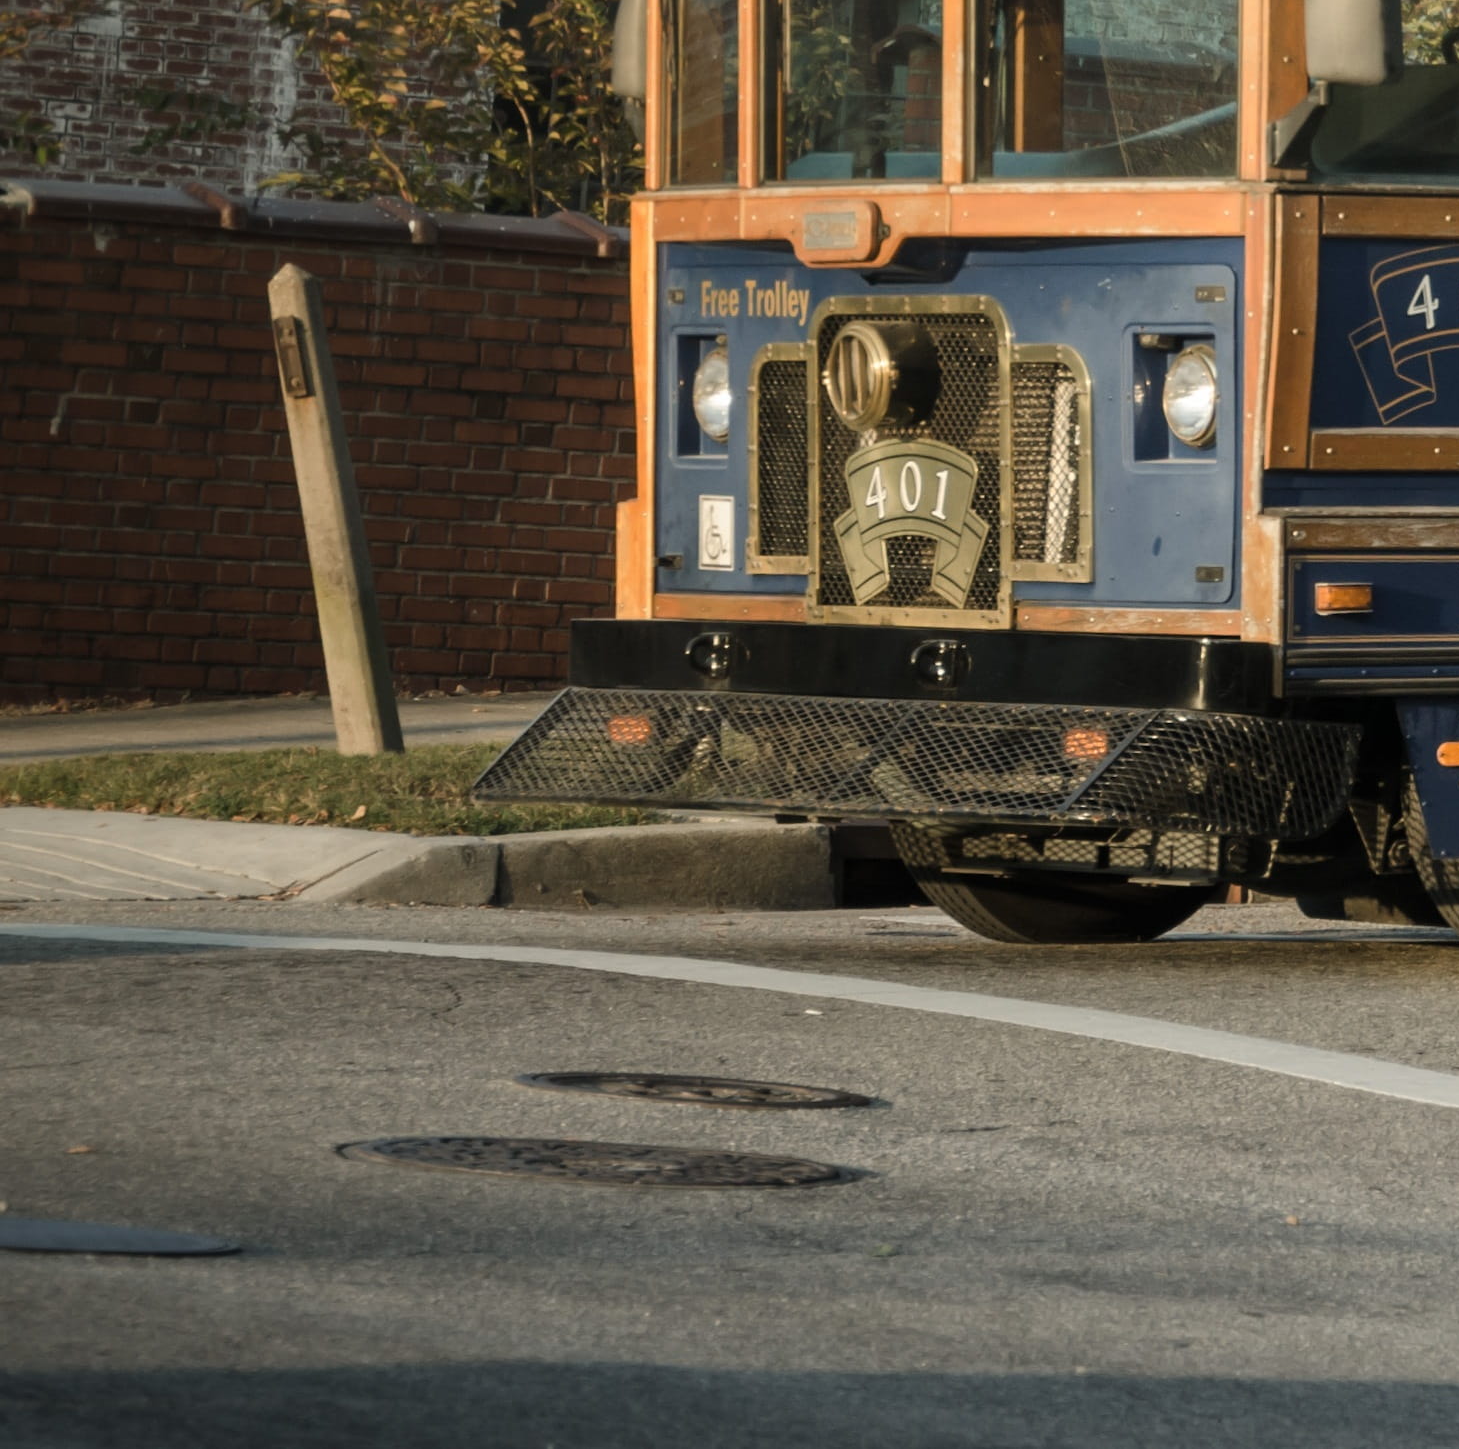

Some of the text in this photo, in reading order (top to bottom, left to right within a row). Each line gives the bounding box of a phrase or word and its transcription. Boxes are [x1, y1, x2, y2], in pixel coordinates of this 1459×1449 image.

[701, 280, 811, 327] Free Trolley
[865, 460, 949, 520] 401
